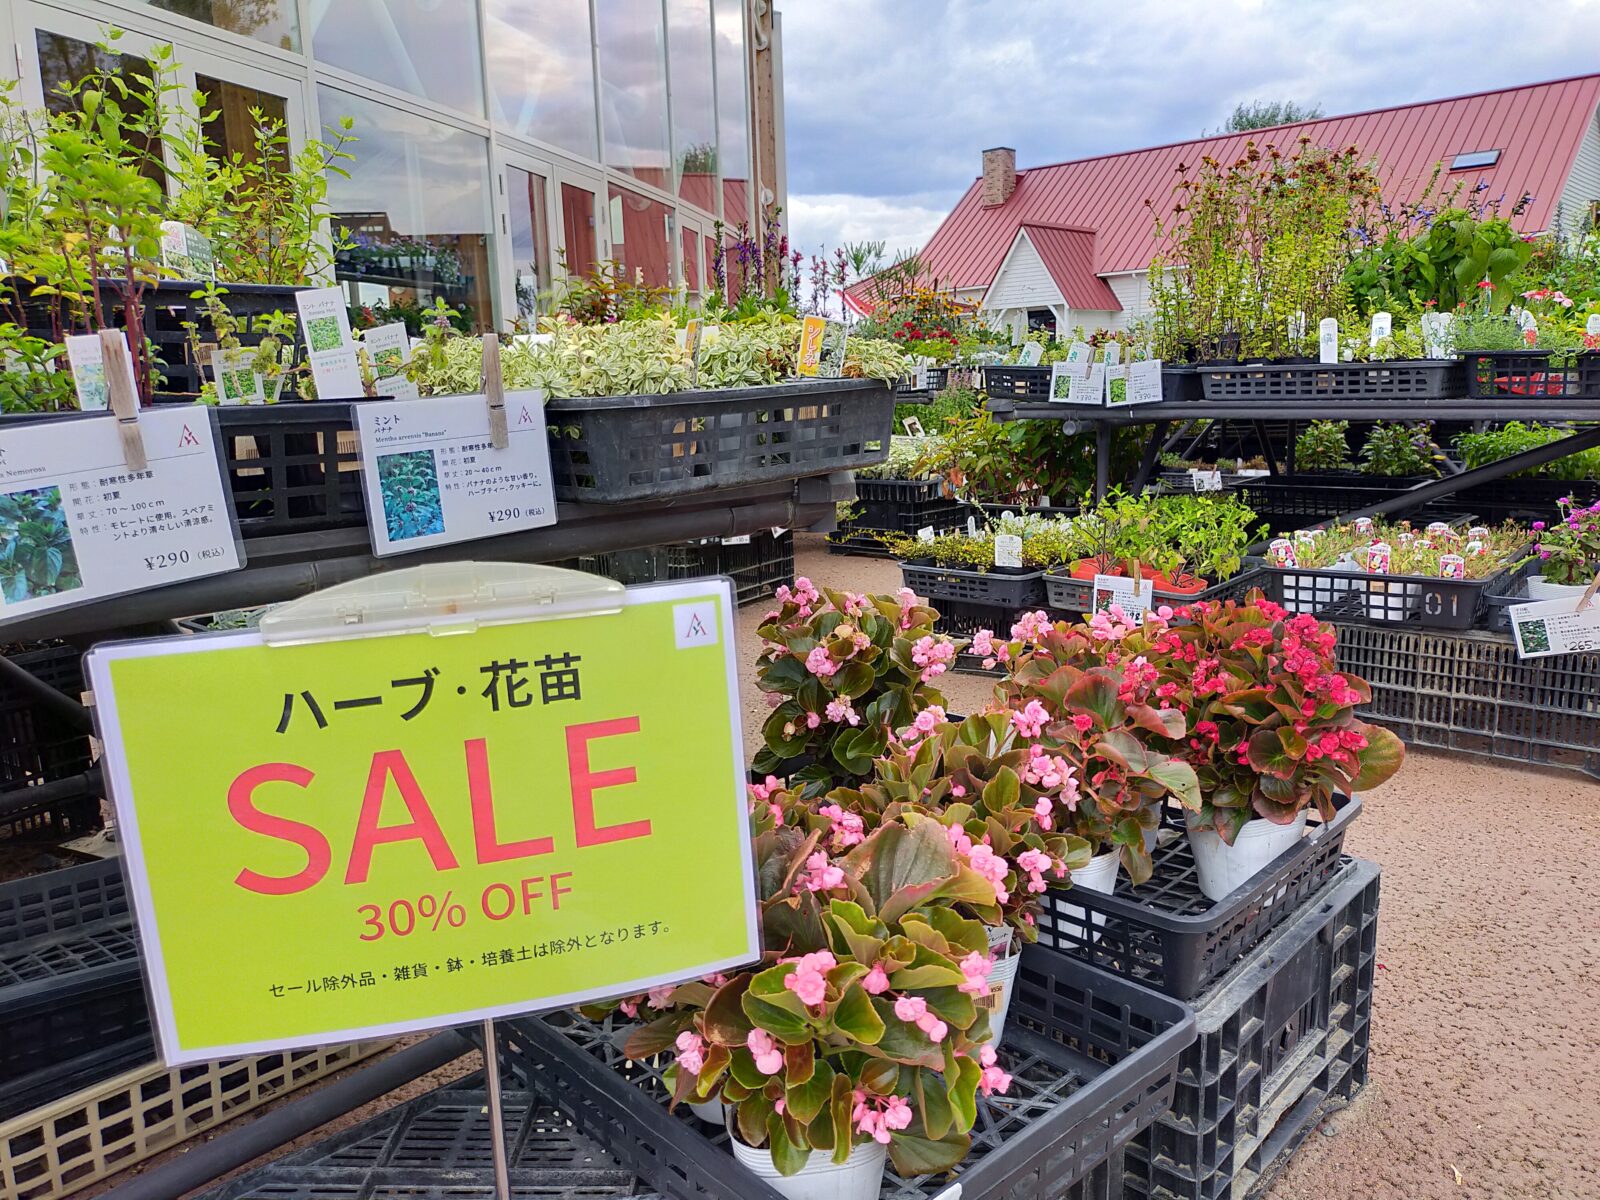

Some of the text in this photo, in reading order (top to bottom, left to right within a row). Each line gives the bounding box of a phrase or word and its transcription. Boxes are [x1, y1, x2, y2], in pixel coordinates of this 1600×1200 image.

[802, 324, 821, 367] シレネ
[374, 414, 400, 426] ミント
[374, 426, 392, 434] バナナ
[6, 465, 46, 478] Nemorosa
[488, 508, 520, 522] ¥290
[144, 549, 190, 570] ¥290
[274, 651, 583, 734] ハーブ・花苗
[226, 715, 652, 896] SALE
[358, 871, 574, 942] 30% OFF
[268, 921, 672, 999] セール除外品・雑貨・鉢・培養土は除外となります。
